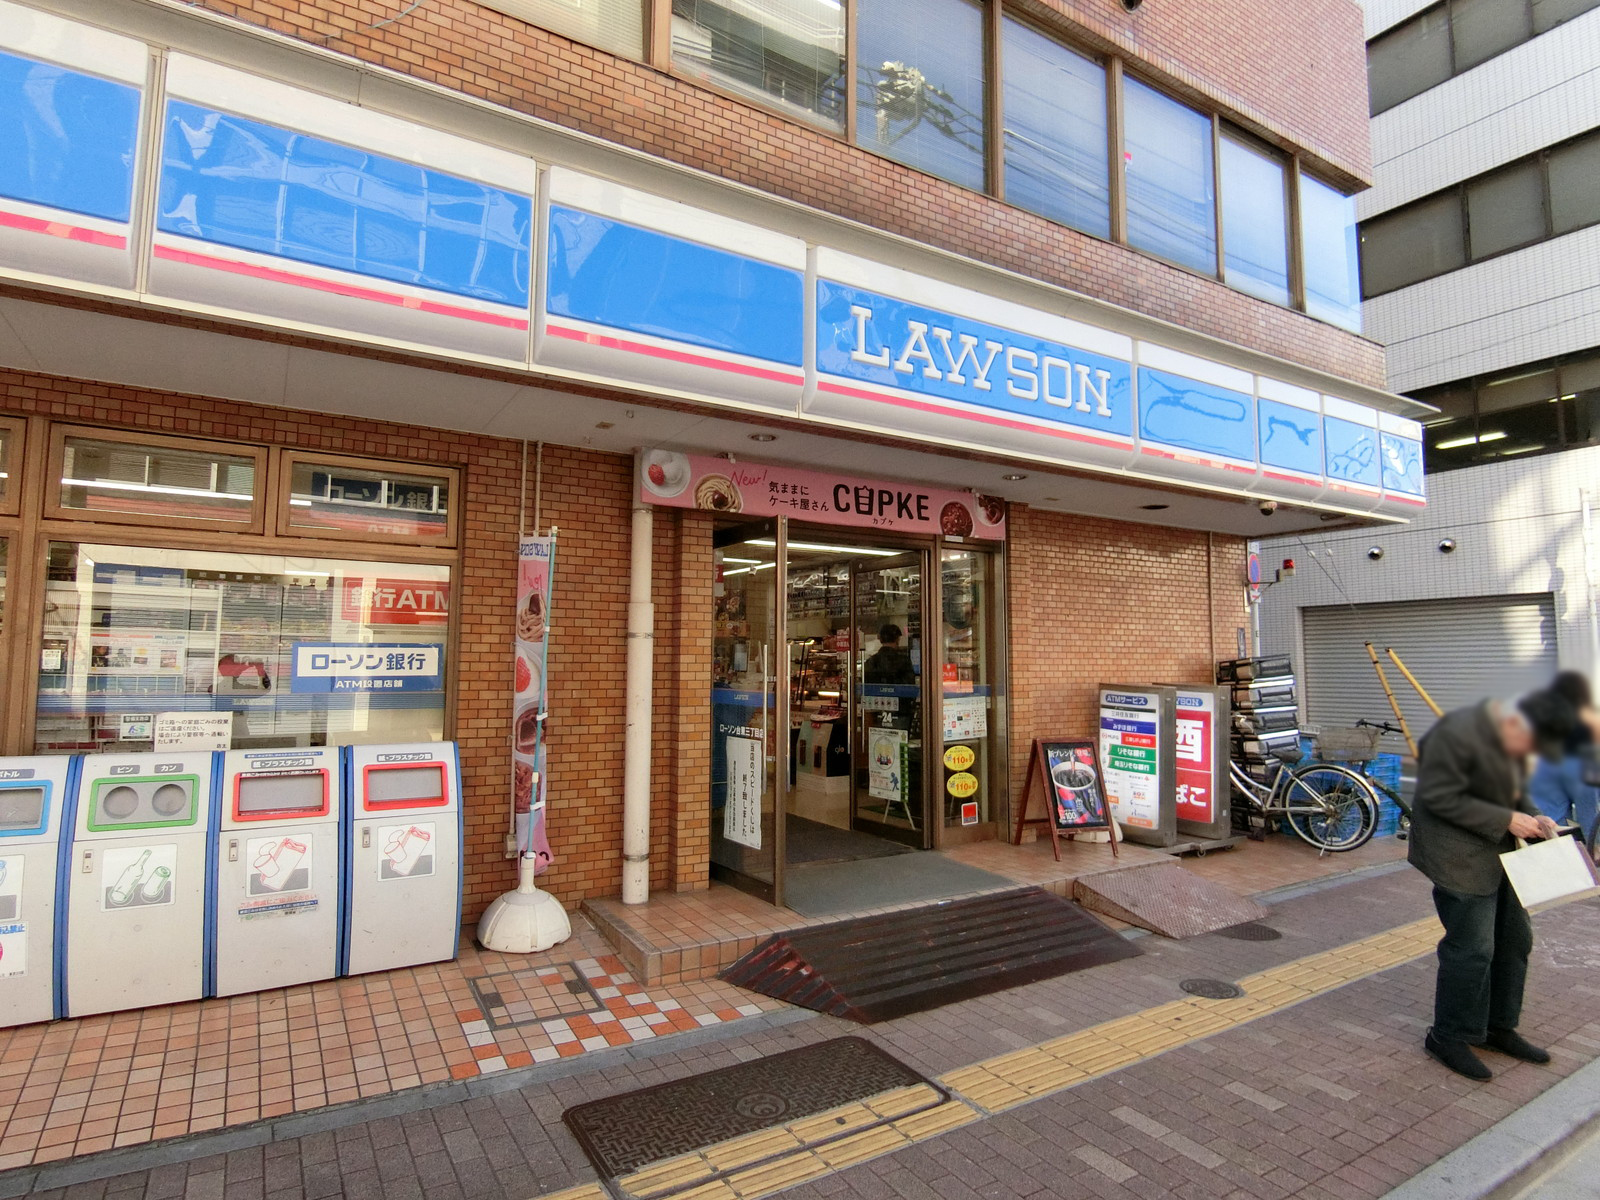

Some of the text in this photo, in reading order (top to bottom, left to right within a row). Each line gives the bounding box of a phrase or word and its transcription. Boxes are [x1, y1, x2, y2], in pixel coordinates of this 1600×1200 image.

[851, 305, 1112, 417] LAWSON
[728, 470, 767, 488] New!
[768, 481, 809, 496] 気ままに
[769, 495, 829, 512] ケーキ屋さん
[833, 484, 930, 521] CUPKE
[311, 652, 426, 671] ローソン銀行
[335, 679, 403, 689] ATM設置店舗
[1106, 695, 1146, 705] ATMサービス
[882, 712, 892, 723] 24
[1117, 747, 1146, 758] りそな銀行
[116, 765, 134, 774] ビン
[160, 764, 177, 773] カン
